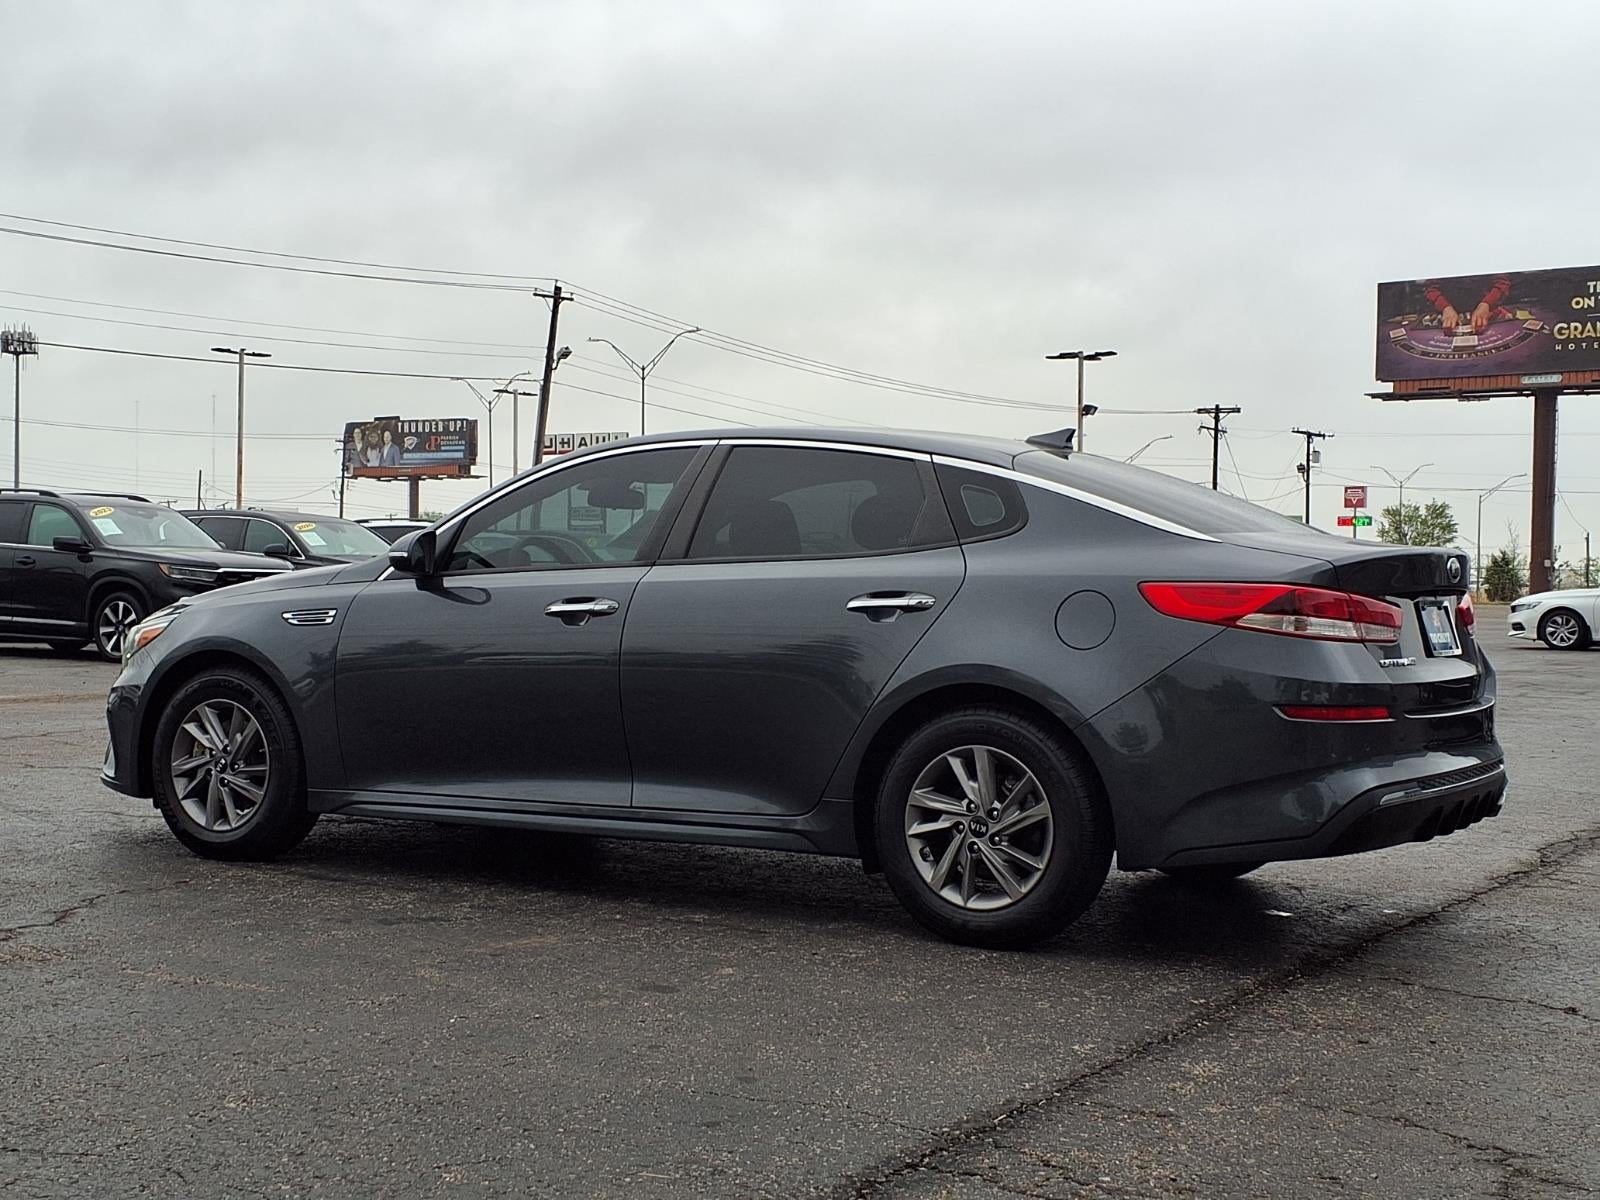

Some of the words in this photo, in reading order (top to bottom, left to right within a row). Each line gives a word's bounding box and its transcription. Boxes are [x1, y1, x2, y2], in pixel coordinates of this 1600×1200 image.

[1571, 296, 1595, 309] ON
[398, 421, 443, 433] THUNDER
[449, 420, 467, 432] UP!
[970, 820, 987, 833] KIA
